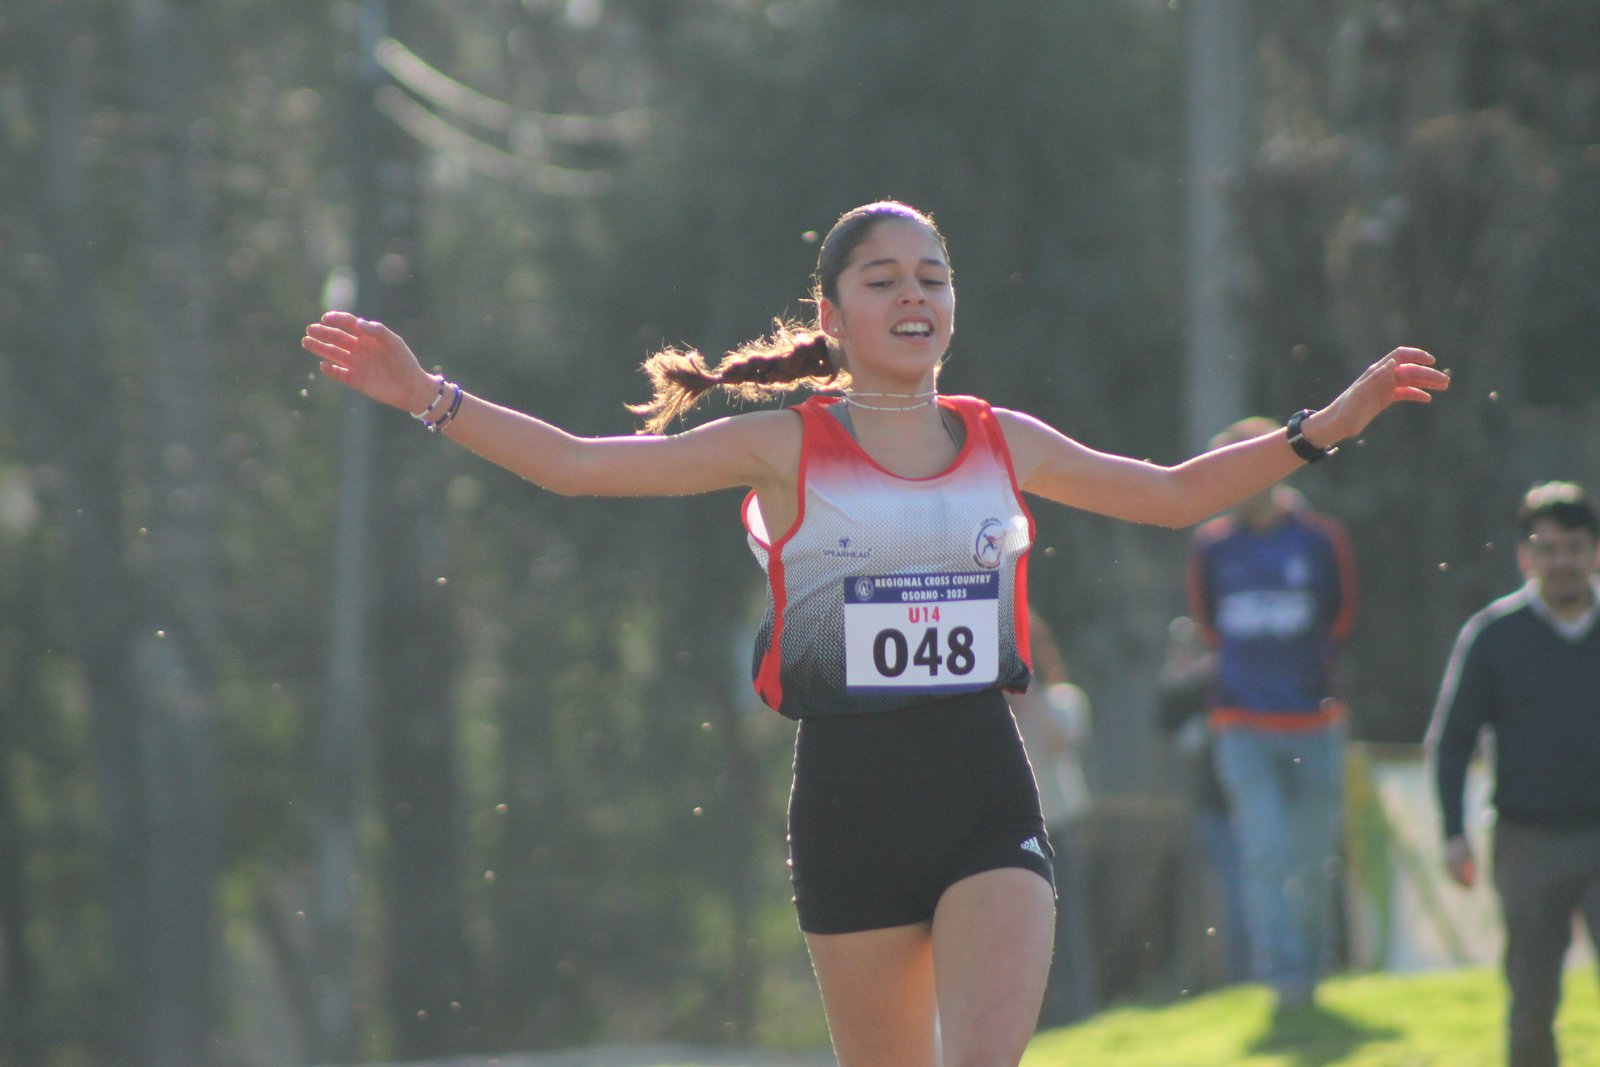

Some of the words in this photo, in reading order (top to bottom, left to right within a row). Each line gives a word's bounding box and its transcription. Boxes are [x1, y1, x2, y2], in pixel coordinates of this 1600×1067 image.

[823, 549, 870, 558] SPEARHEAD
[875, 576, 921, 587] REGIONAL
[925, 575, 949, 585] CROSS
[953, 574, 991, 584] COUNTRY
[902, 590, 938, 600] OSORNO
[946, 589, 967, 599] 2025
[909, 606, 940, 623] U14
[873, 626, 975, 677] 048
